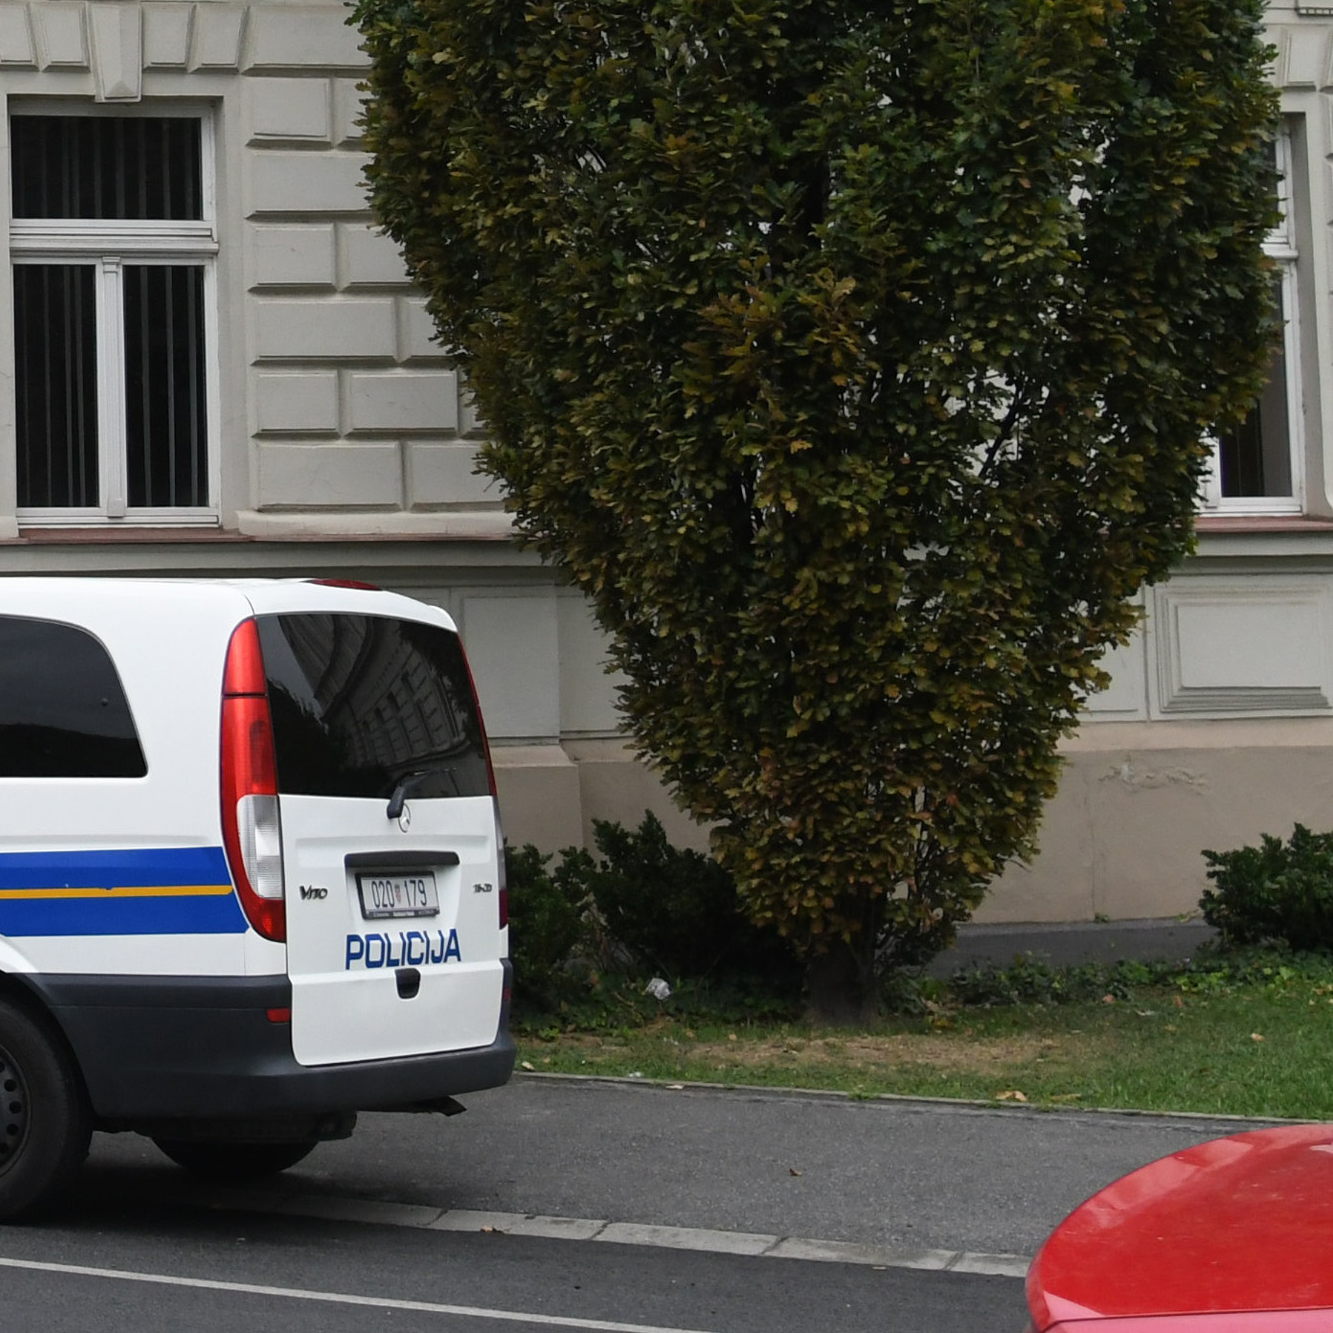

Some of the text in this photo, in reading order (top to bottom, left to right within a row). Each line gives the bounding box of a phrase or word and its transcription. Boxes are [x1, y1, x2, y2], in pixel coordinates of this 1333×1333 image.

[371, 879, 427, 908] 020 179
[345, 928, 462, 970] POLICIJA
